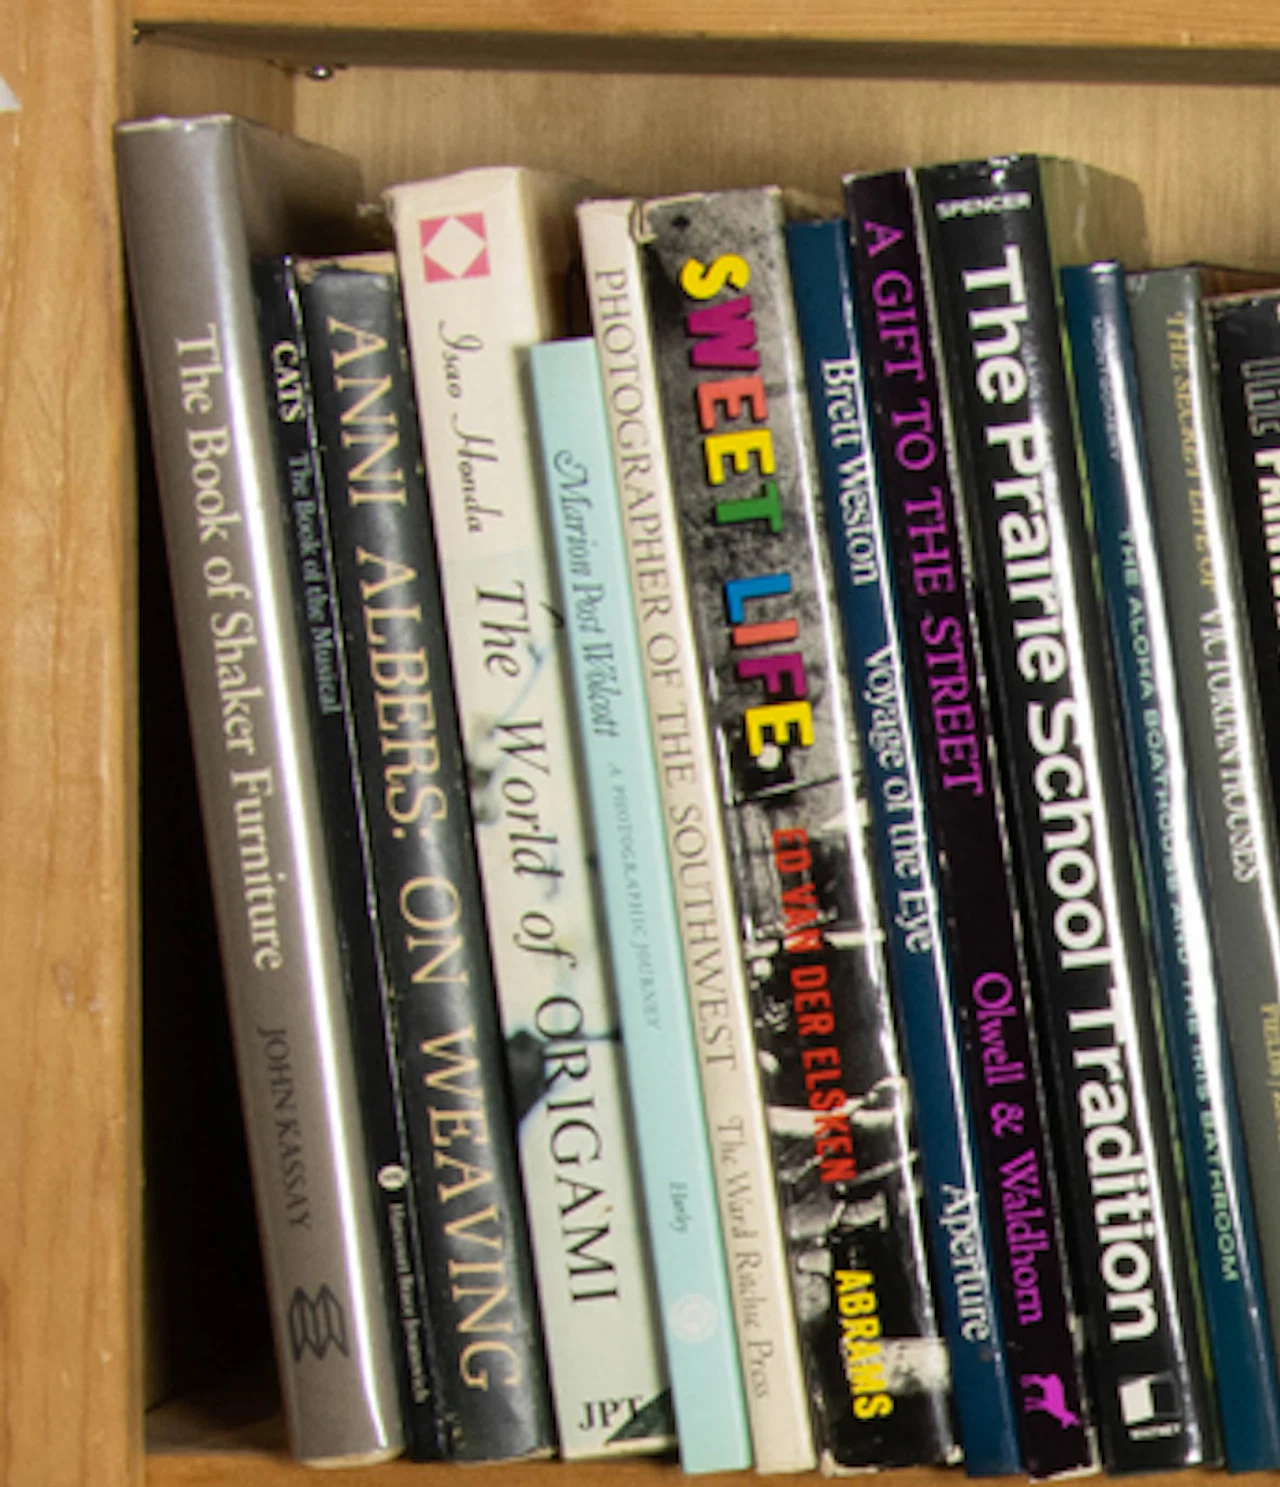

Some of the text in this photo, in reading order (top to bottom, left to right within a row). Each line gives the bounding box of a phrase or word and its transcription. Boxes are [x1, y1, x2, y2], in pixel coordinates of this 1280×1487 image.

[270, 342, 306, 421] CATS
[326, 316, 408, 507] ANNI
[958, 244, 1038, 405] The
[674, 252, 817, 757] SWEET LIFE
[819, 359, 886, 585] Brett Weston
[862, 218, 984, 799] A GIFT TO THE STREET
[983, 419, 1074, 683] Prairie
[171, 325, 296, 971] The Book of Shaker Furniture
[594, 267, 736, 1069] PHOTOGRAPHER OF THE SOUTHWEST
[395, 875, 469, 984] ON
[474, 579, 619, 1305] The World of ORIGAMI
[1021, 695, 1114, 968] School
[257, 1025, 312, 1231] JOHN KASSAY
[416, 1027, 522, 1391] WEAVING
[969, 970, 1057, 1323] Olwell & Waldhorn
[1062, 986, 1166, 1340] Tradition
[830, 1269, 894, 1418] ABRAMS
